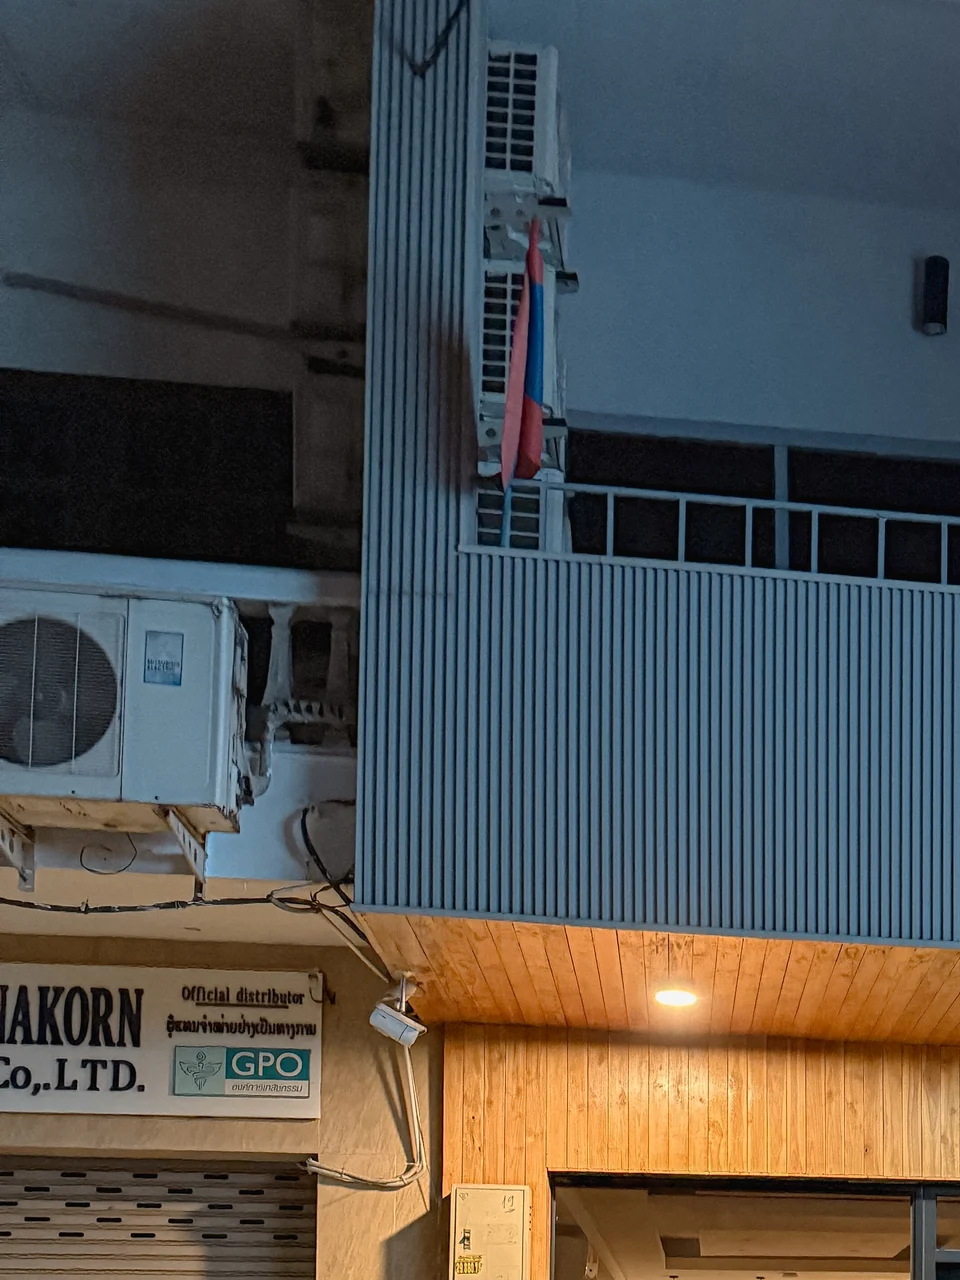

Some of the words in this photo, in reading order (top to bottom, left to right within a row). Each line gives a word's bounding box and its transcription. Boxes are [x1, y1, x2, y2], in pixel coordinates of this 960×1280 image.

[182, 986, 230, 1003] Official
[236, 988, 305, 1005] distributor
[231, 1051, 303, 1077] GPO
